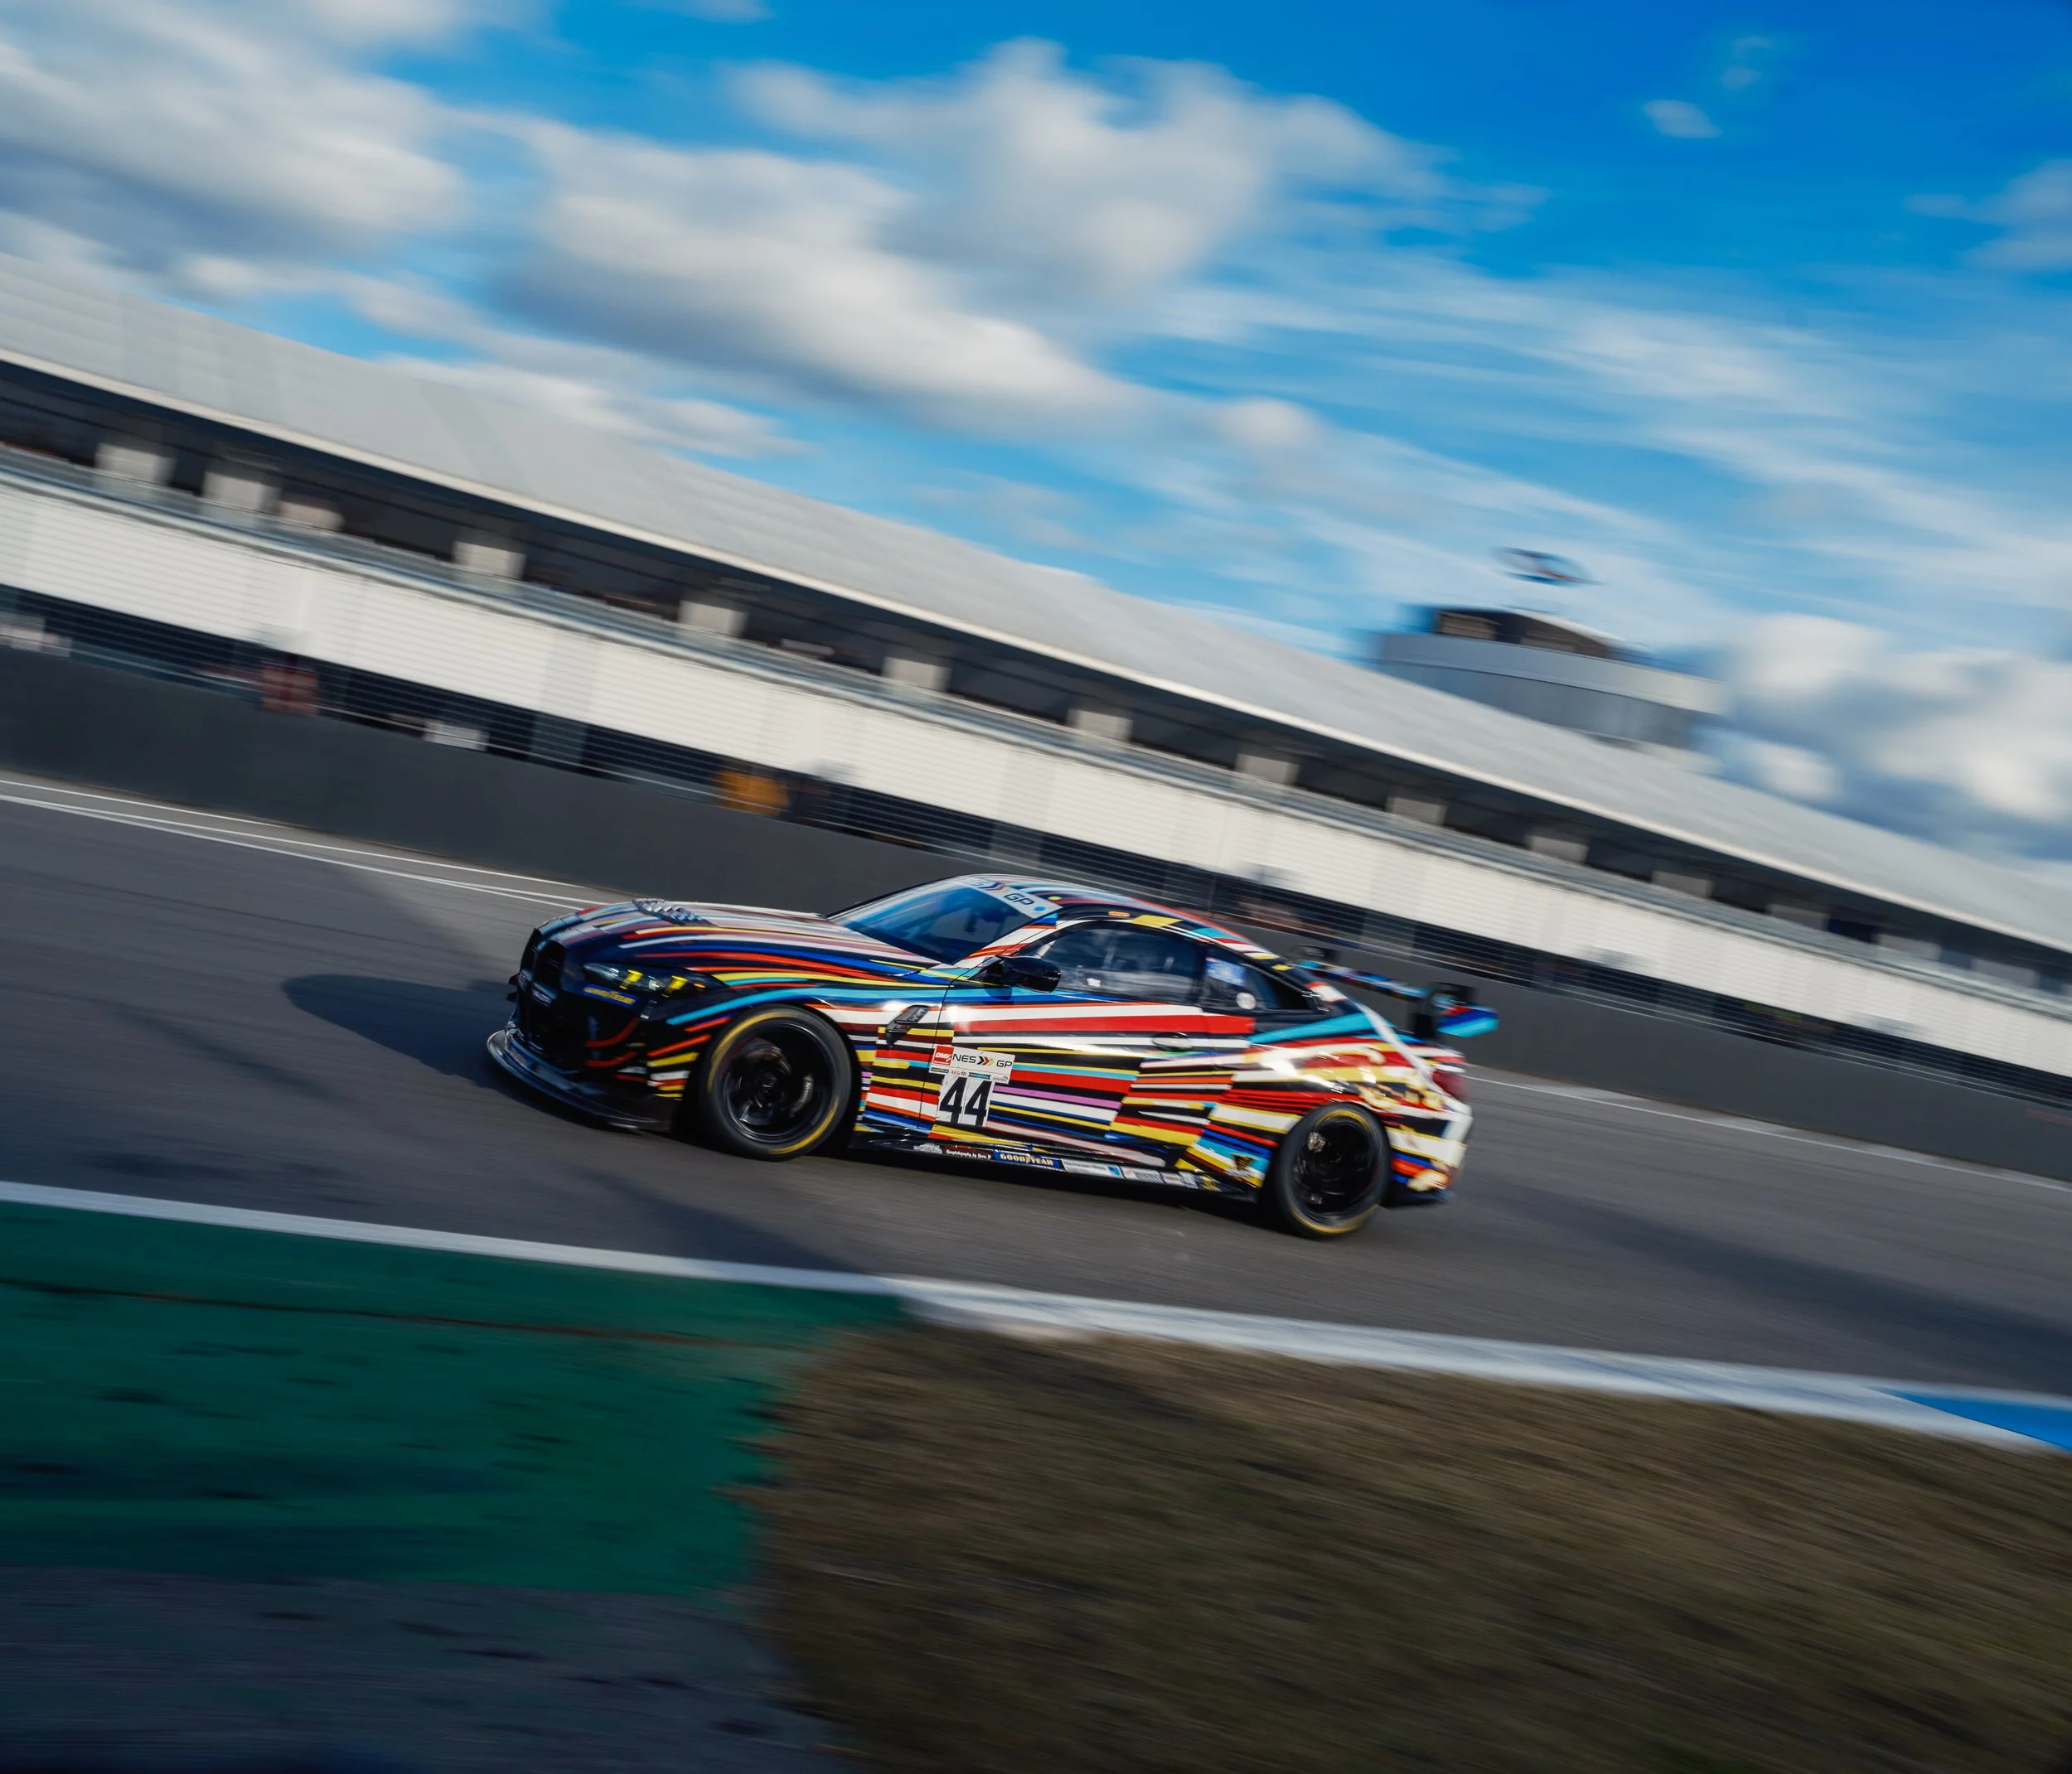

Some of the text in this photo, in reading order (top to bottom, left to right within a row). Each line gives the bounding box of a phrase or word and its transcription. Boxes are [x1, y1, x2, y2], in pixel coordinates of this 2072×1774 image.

[1004, 893, 1034, 905] GP
[952, 1053, 1013, 1068] NES GP
[939, 1076, 992, 1127] 44
[1000, 1153, 1053, 1166] GOODYEAR
